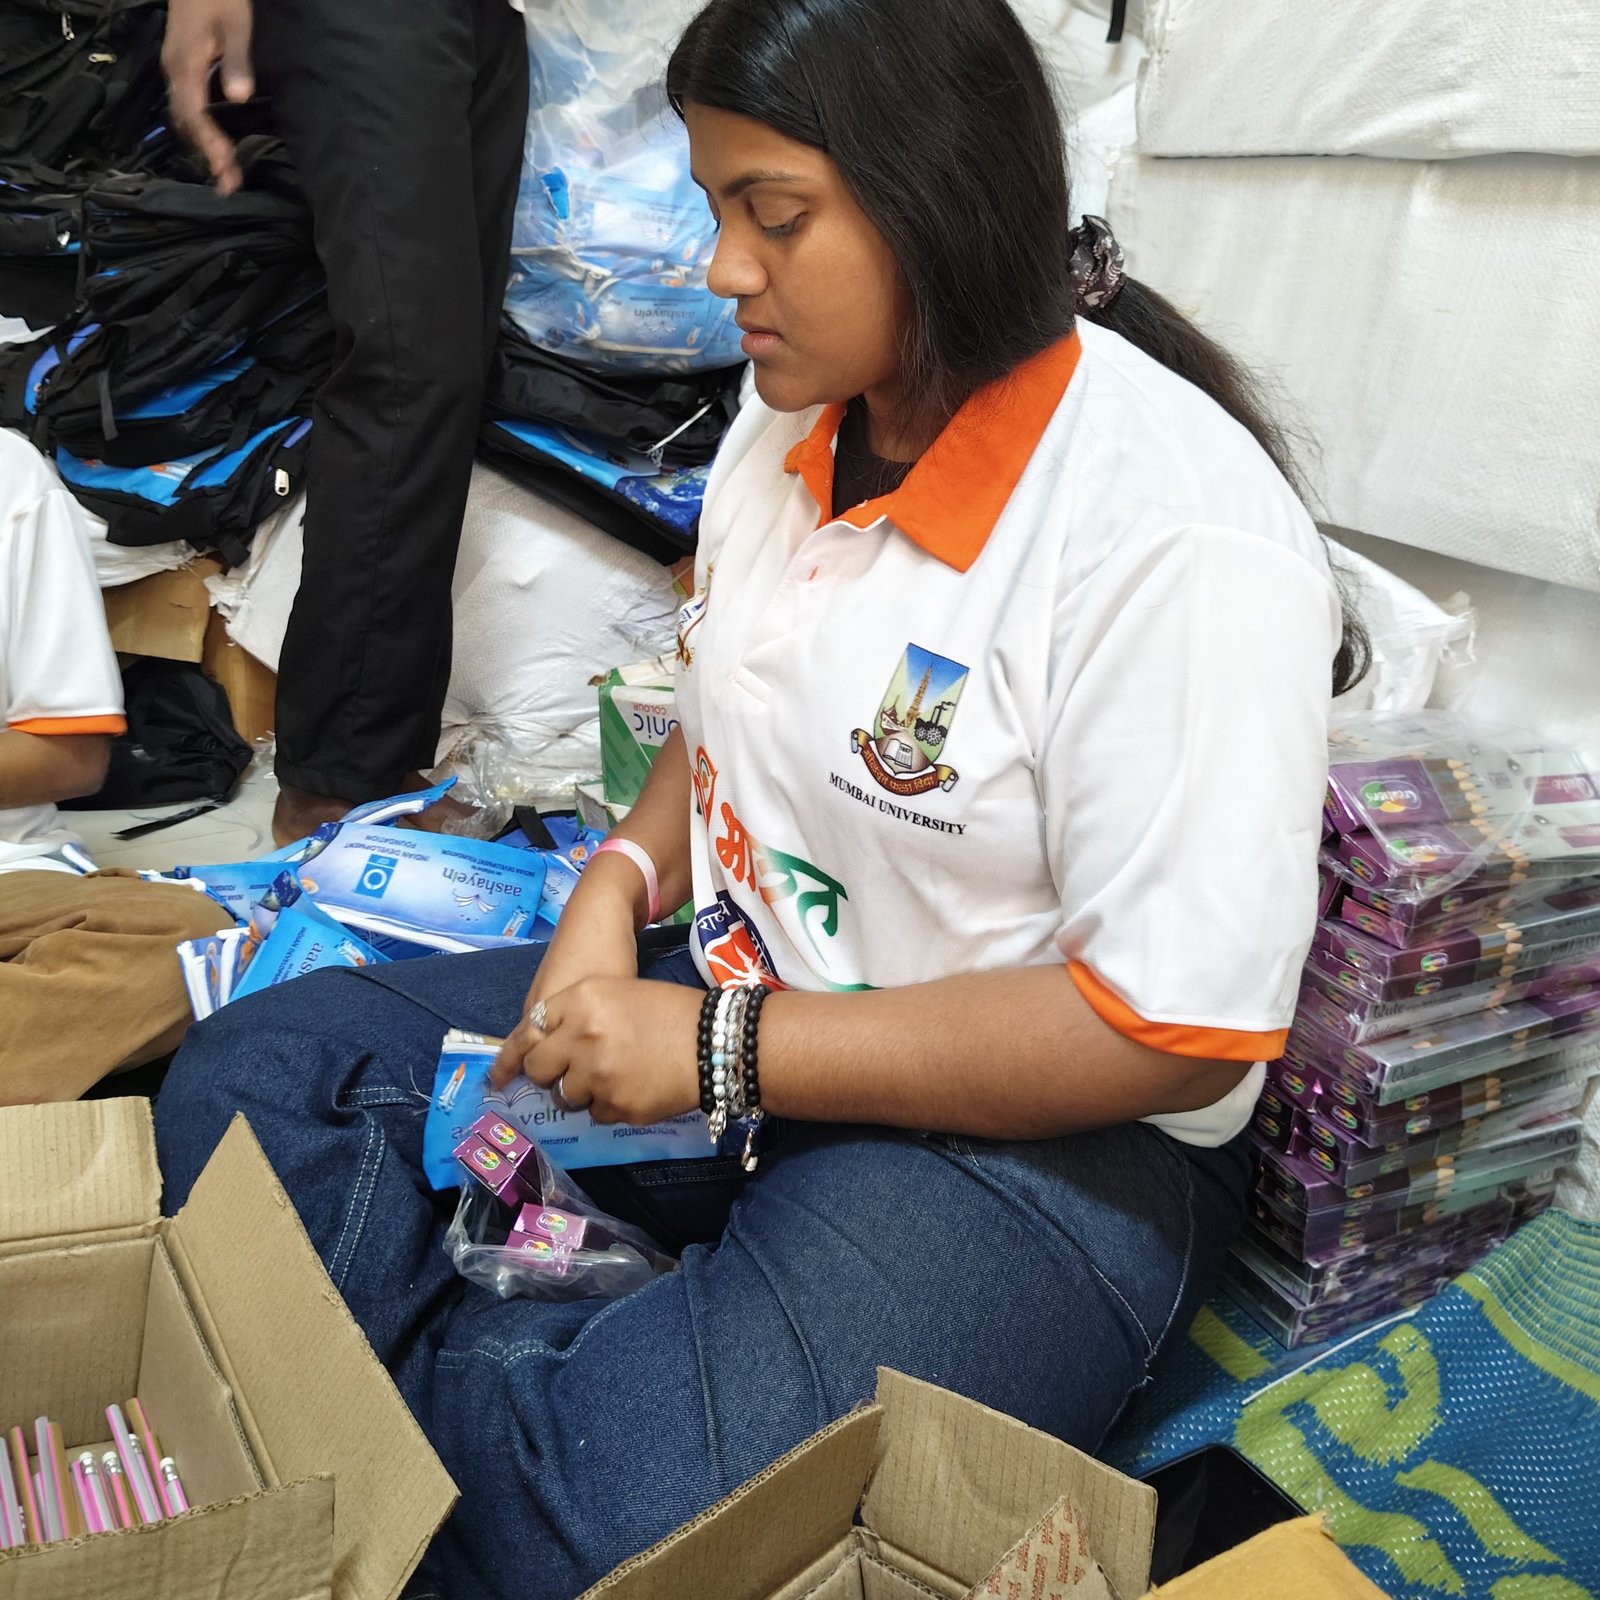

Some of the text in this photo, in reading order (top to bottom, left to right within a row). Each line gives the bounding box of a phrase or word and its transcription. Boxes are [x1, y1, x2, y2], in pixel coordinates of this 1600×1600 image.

[829, 772, 967, 836] MUMBAI UNIVERSITY
[343, 842, 431, 861] INDIAN DEVELOPMENT
[365, 834, 417, 849] FOUNDATION
[442, 866, 523, 897] aashayein
